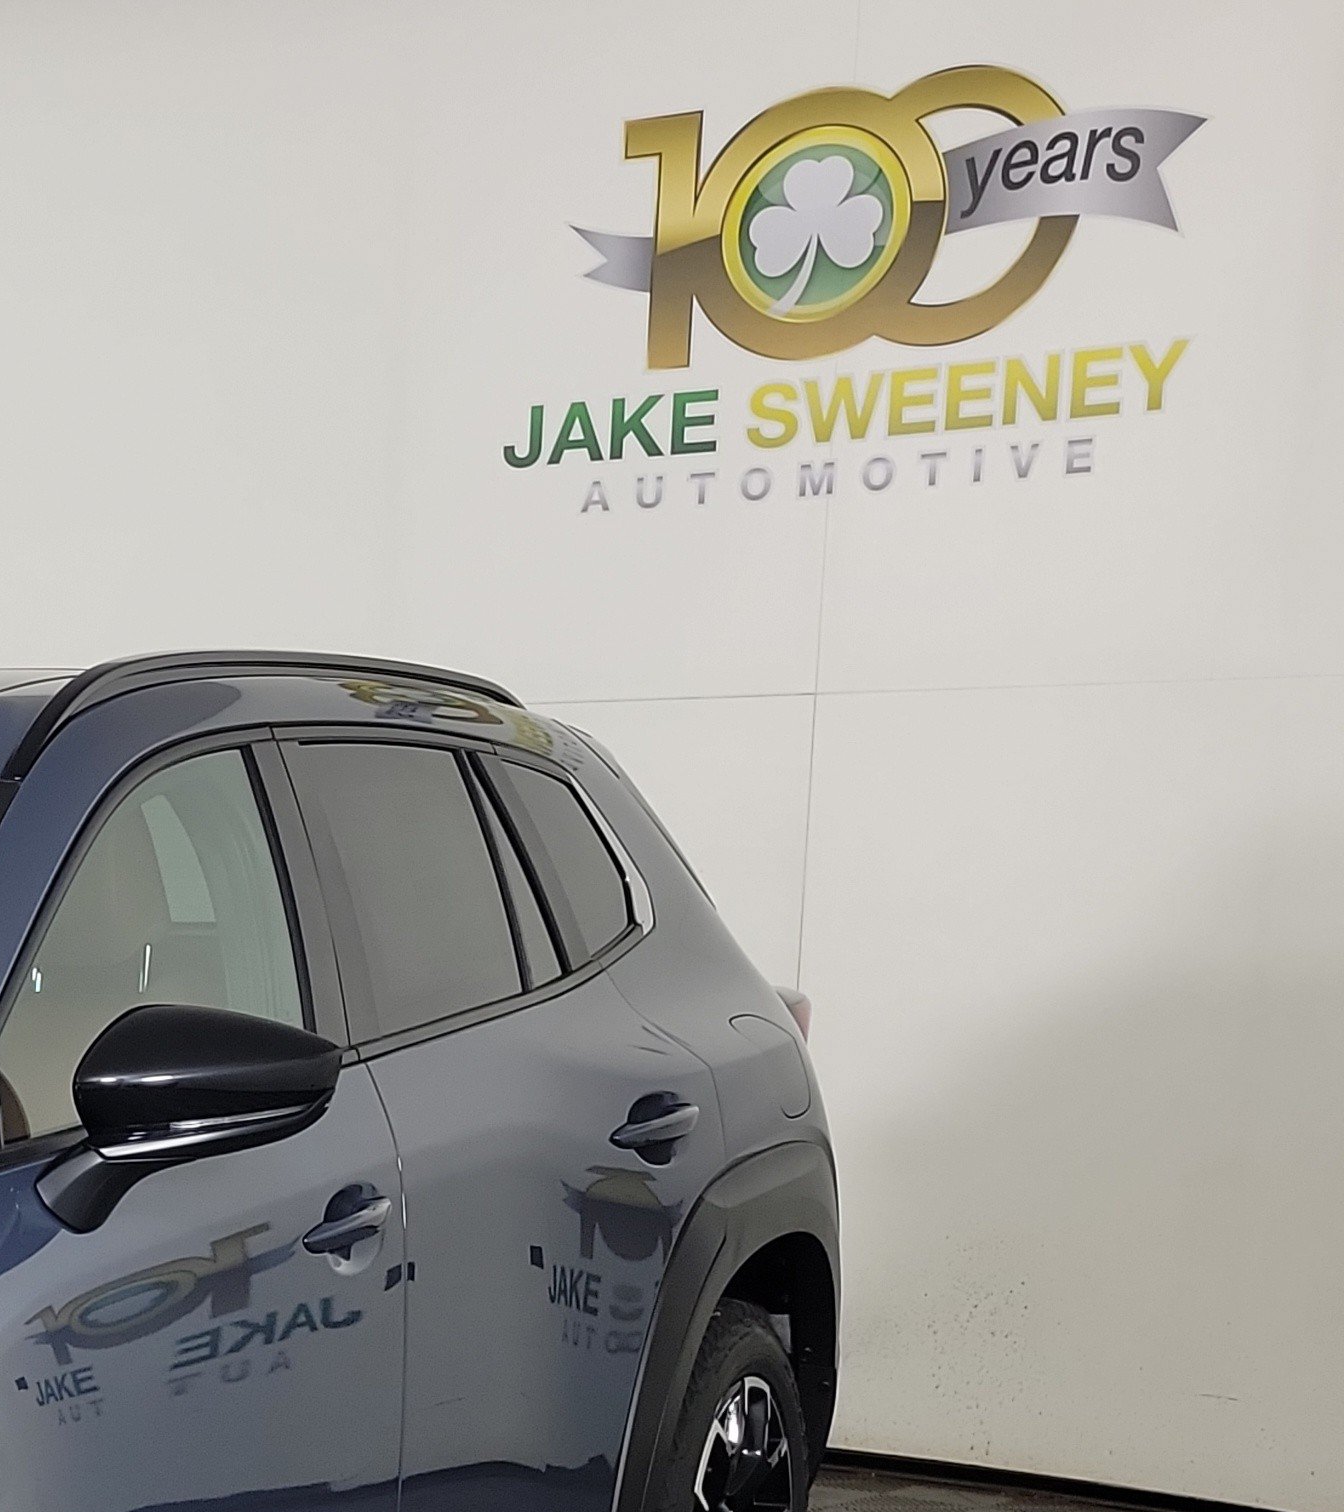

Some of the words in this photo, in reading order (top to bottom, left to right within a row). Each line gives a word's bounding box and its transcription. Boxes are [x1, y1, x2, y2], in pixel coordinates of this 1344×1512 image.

[959, 124, 1145, 219] years
[624, 63, 1080, 370] 100
[503, 388, 720, 468] JAKE
[745, 338, 1190, 450] SWEENEY
[579, 437, 1095, 514] AUTOMOTIVE
[548, 1265, 601, 1317] JAKE
[36, 1366, 101, 1407] JAKE
